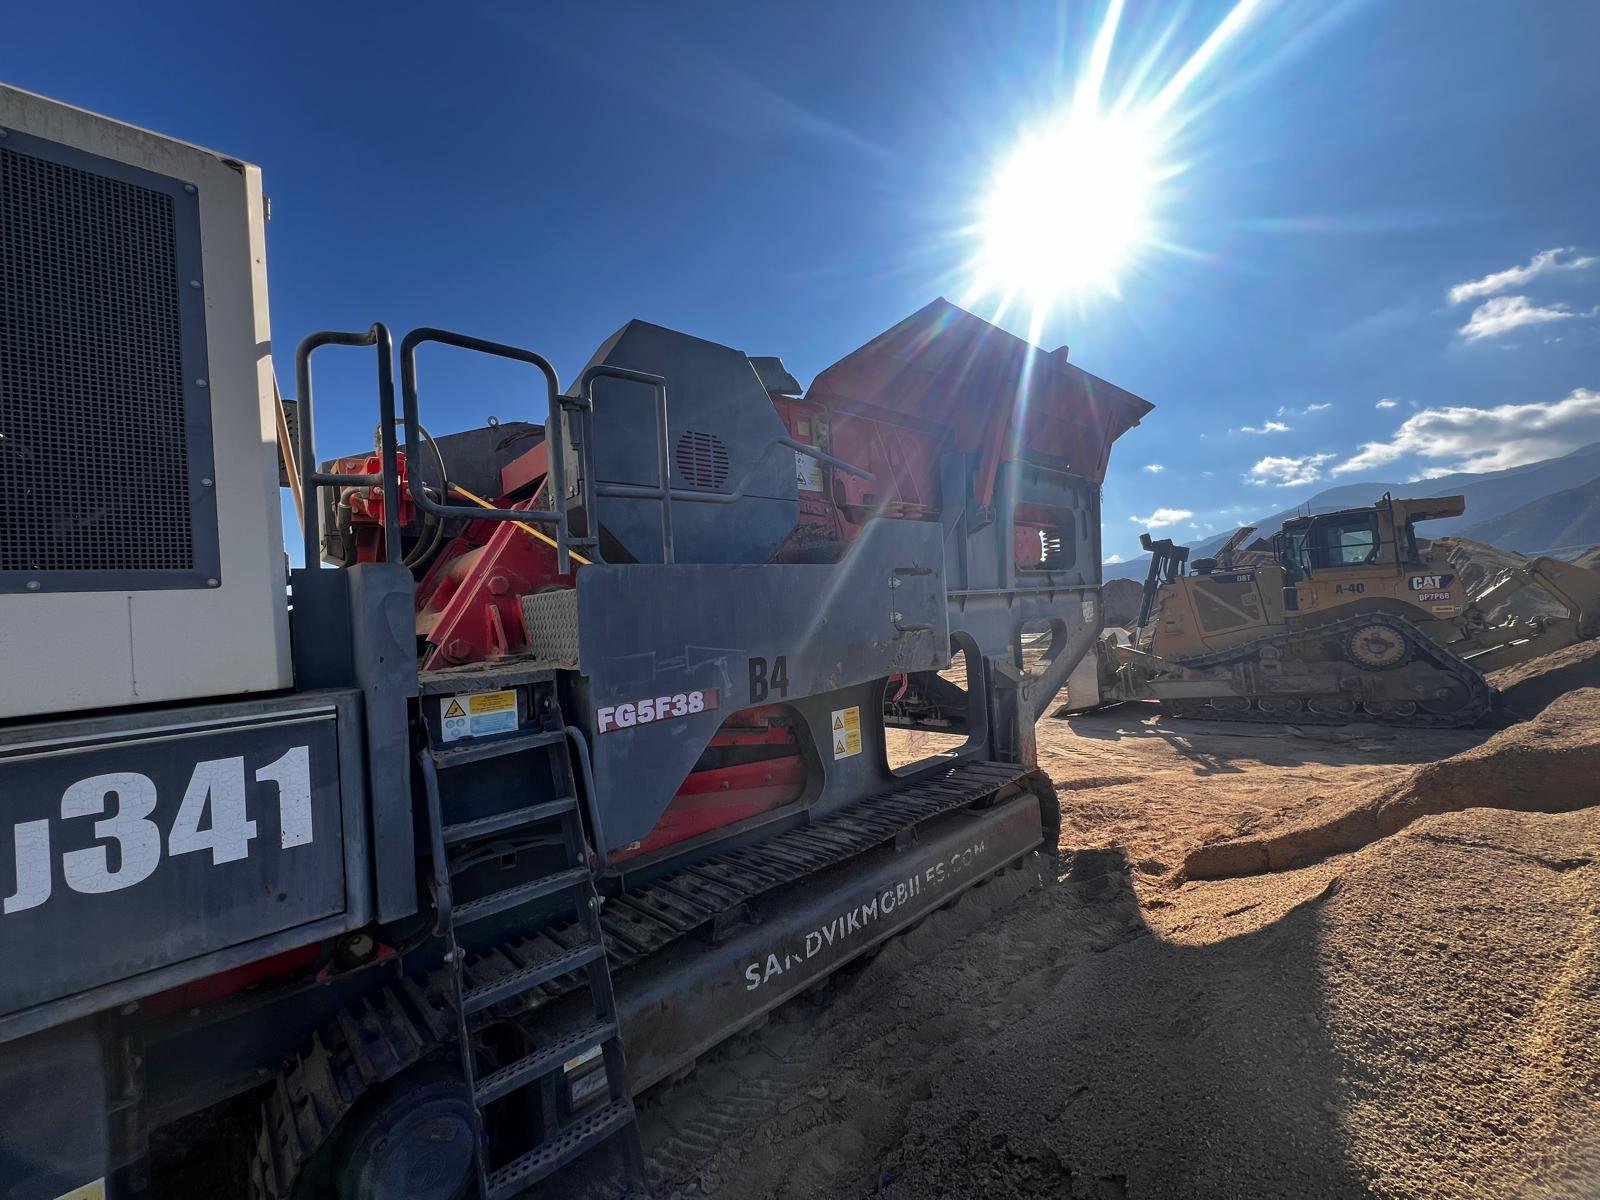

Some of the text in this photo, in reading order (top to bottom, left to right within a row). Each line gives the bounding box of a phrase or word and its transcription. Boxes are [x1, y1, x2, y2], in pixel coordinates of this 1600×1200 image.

[1335, 583, 1365, 594] A-40
[1412, 575, 1442, 590] CAT
[748, 655, 790, 705] B4
[597, 690, 705, 734] FG5F38
